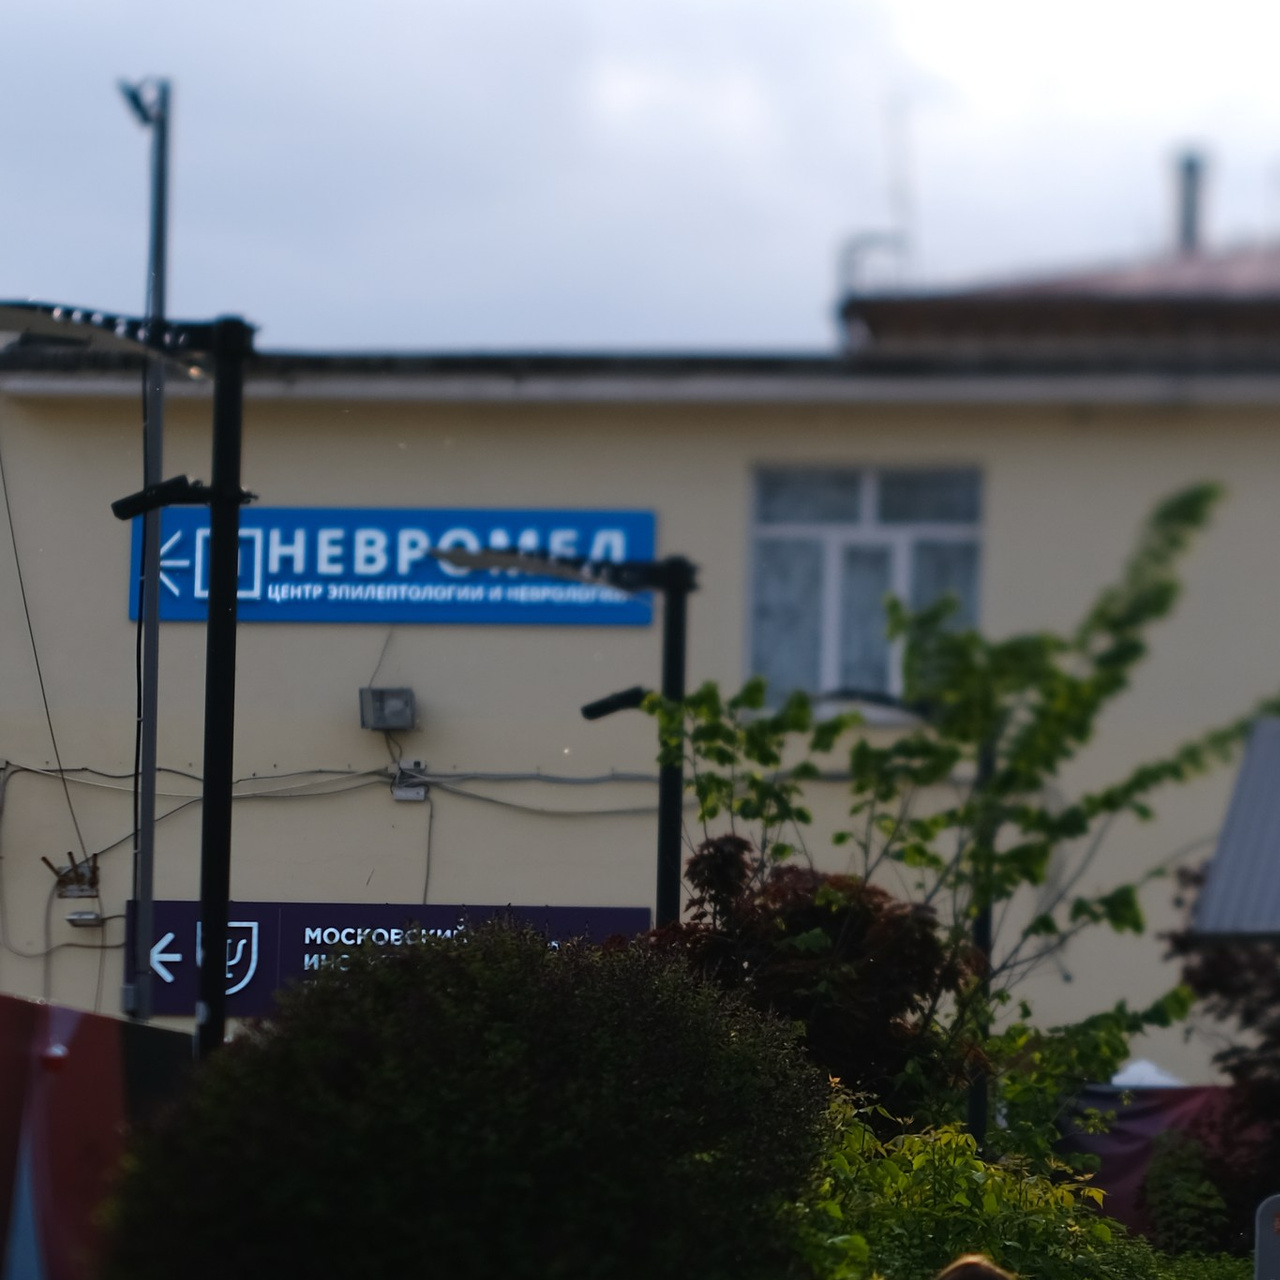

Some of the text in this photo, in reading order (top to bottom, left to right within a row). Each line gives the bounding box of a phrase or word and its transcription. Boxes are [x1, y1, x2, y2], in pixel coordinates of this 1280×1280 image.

[268, 583, 323, 603] ЦЕНТР
[327, 584, 483, 602] ЭПИЛЕПТОЛОГИИ
[488, 585, 503, 602] И
